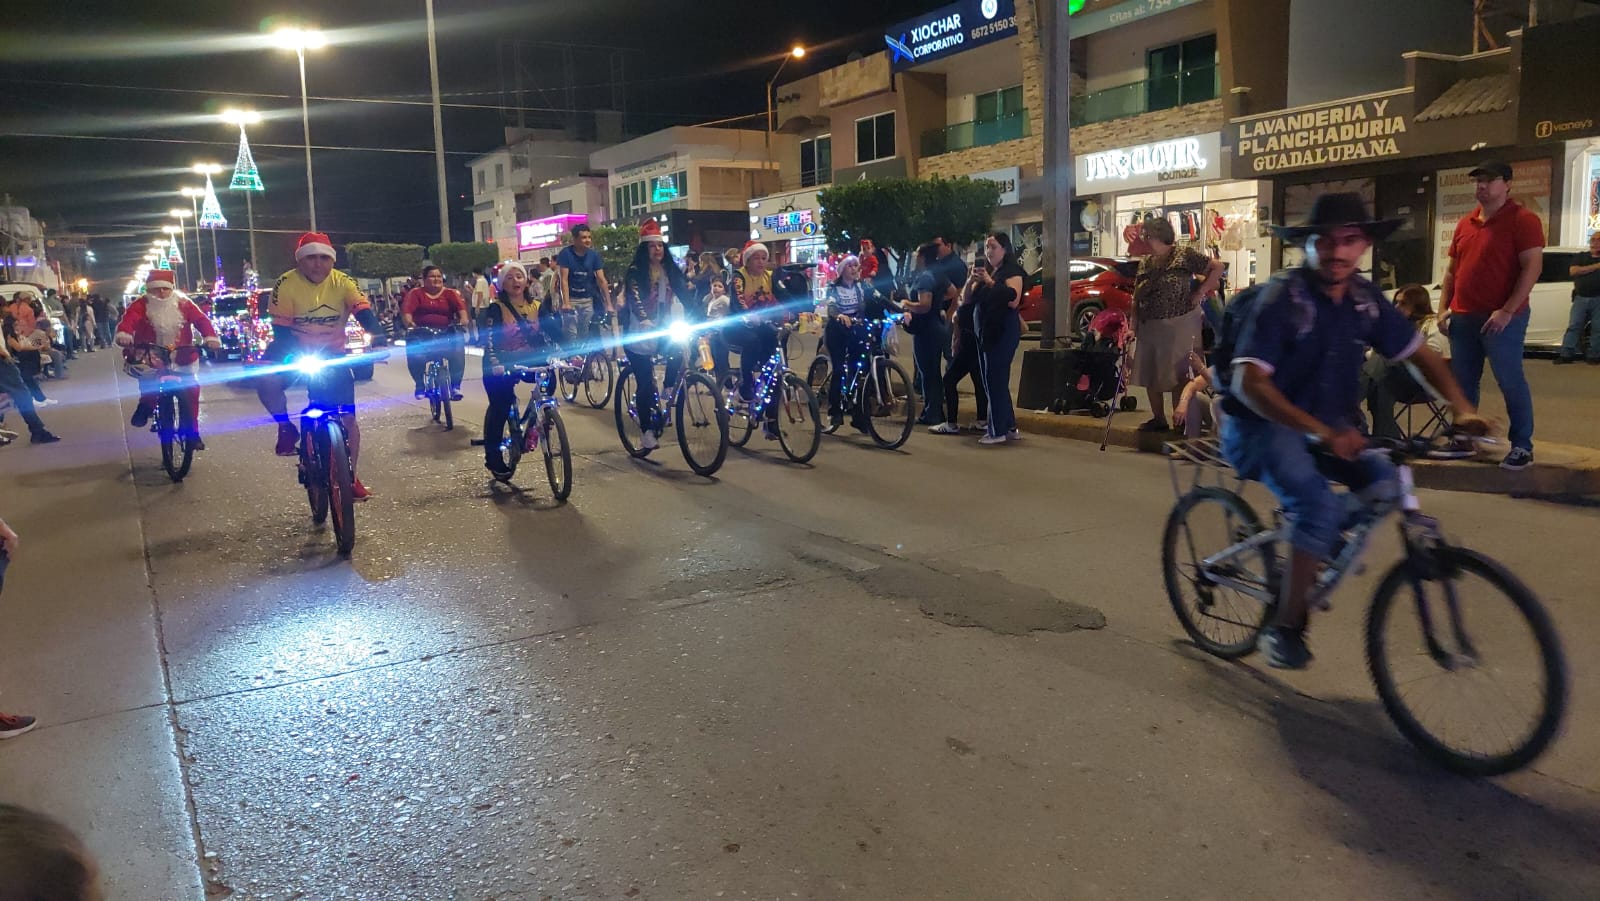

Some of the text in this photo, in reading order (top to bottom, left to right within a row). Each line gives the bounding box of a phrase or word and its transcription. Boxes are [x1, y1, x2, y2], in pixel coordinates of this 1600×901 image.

[910, 13, 962, 44] XIOCHAR
[913, 32, 964, 58] CORPORATIVO
[1239, 99, 1389, 138] LAVANDERIA Y
[1238, 116, 1406, 156] PLANCHADURIA
[1253, 138, 1400, 172] GUADALUPANA
[1157, 168, 1200, 182] BOUTIQUE
